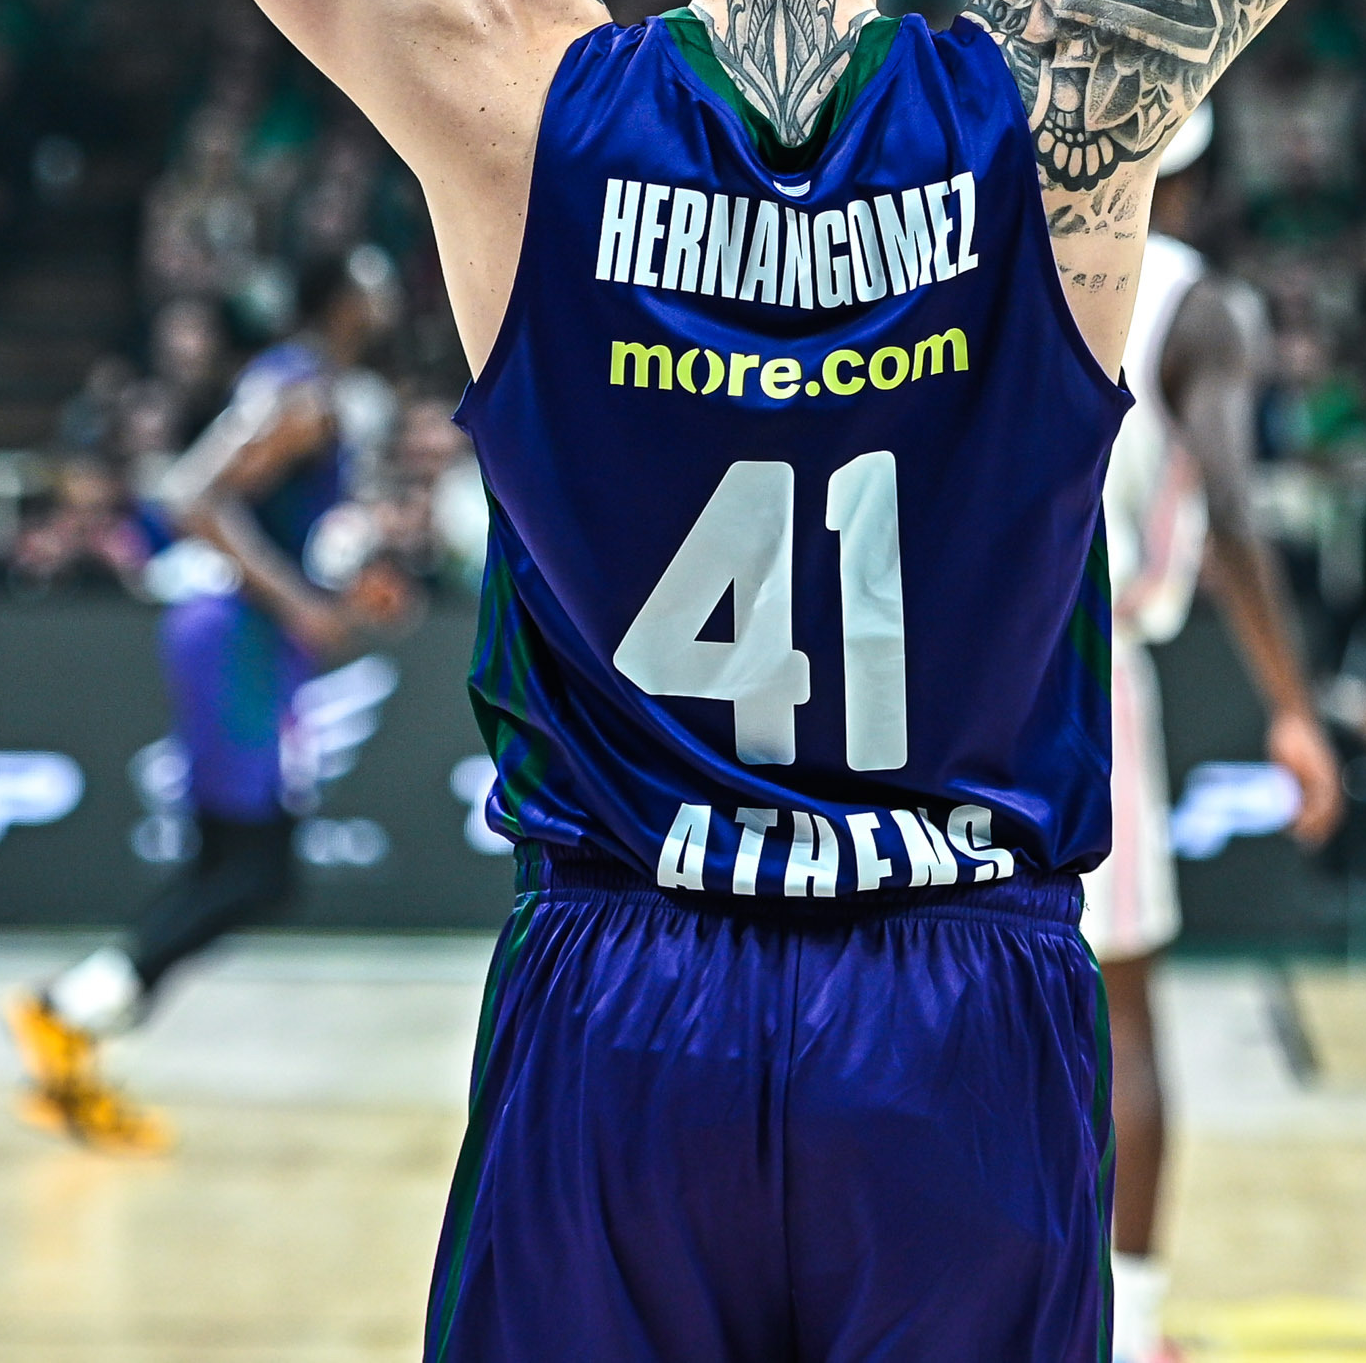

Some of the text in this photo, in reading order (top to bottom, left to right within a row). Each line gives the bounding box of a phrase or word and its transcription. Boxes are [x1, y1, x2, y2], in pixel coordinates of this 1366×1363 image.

[595, 171, 980, 309] HERNANGOMEZ
[609, 323, 971, 400] more.com
[613, 450, 909, 772] 41
[656, 802, 1015, 898] ATHENS
